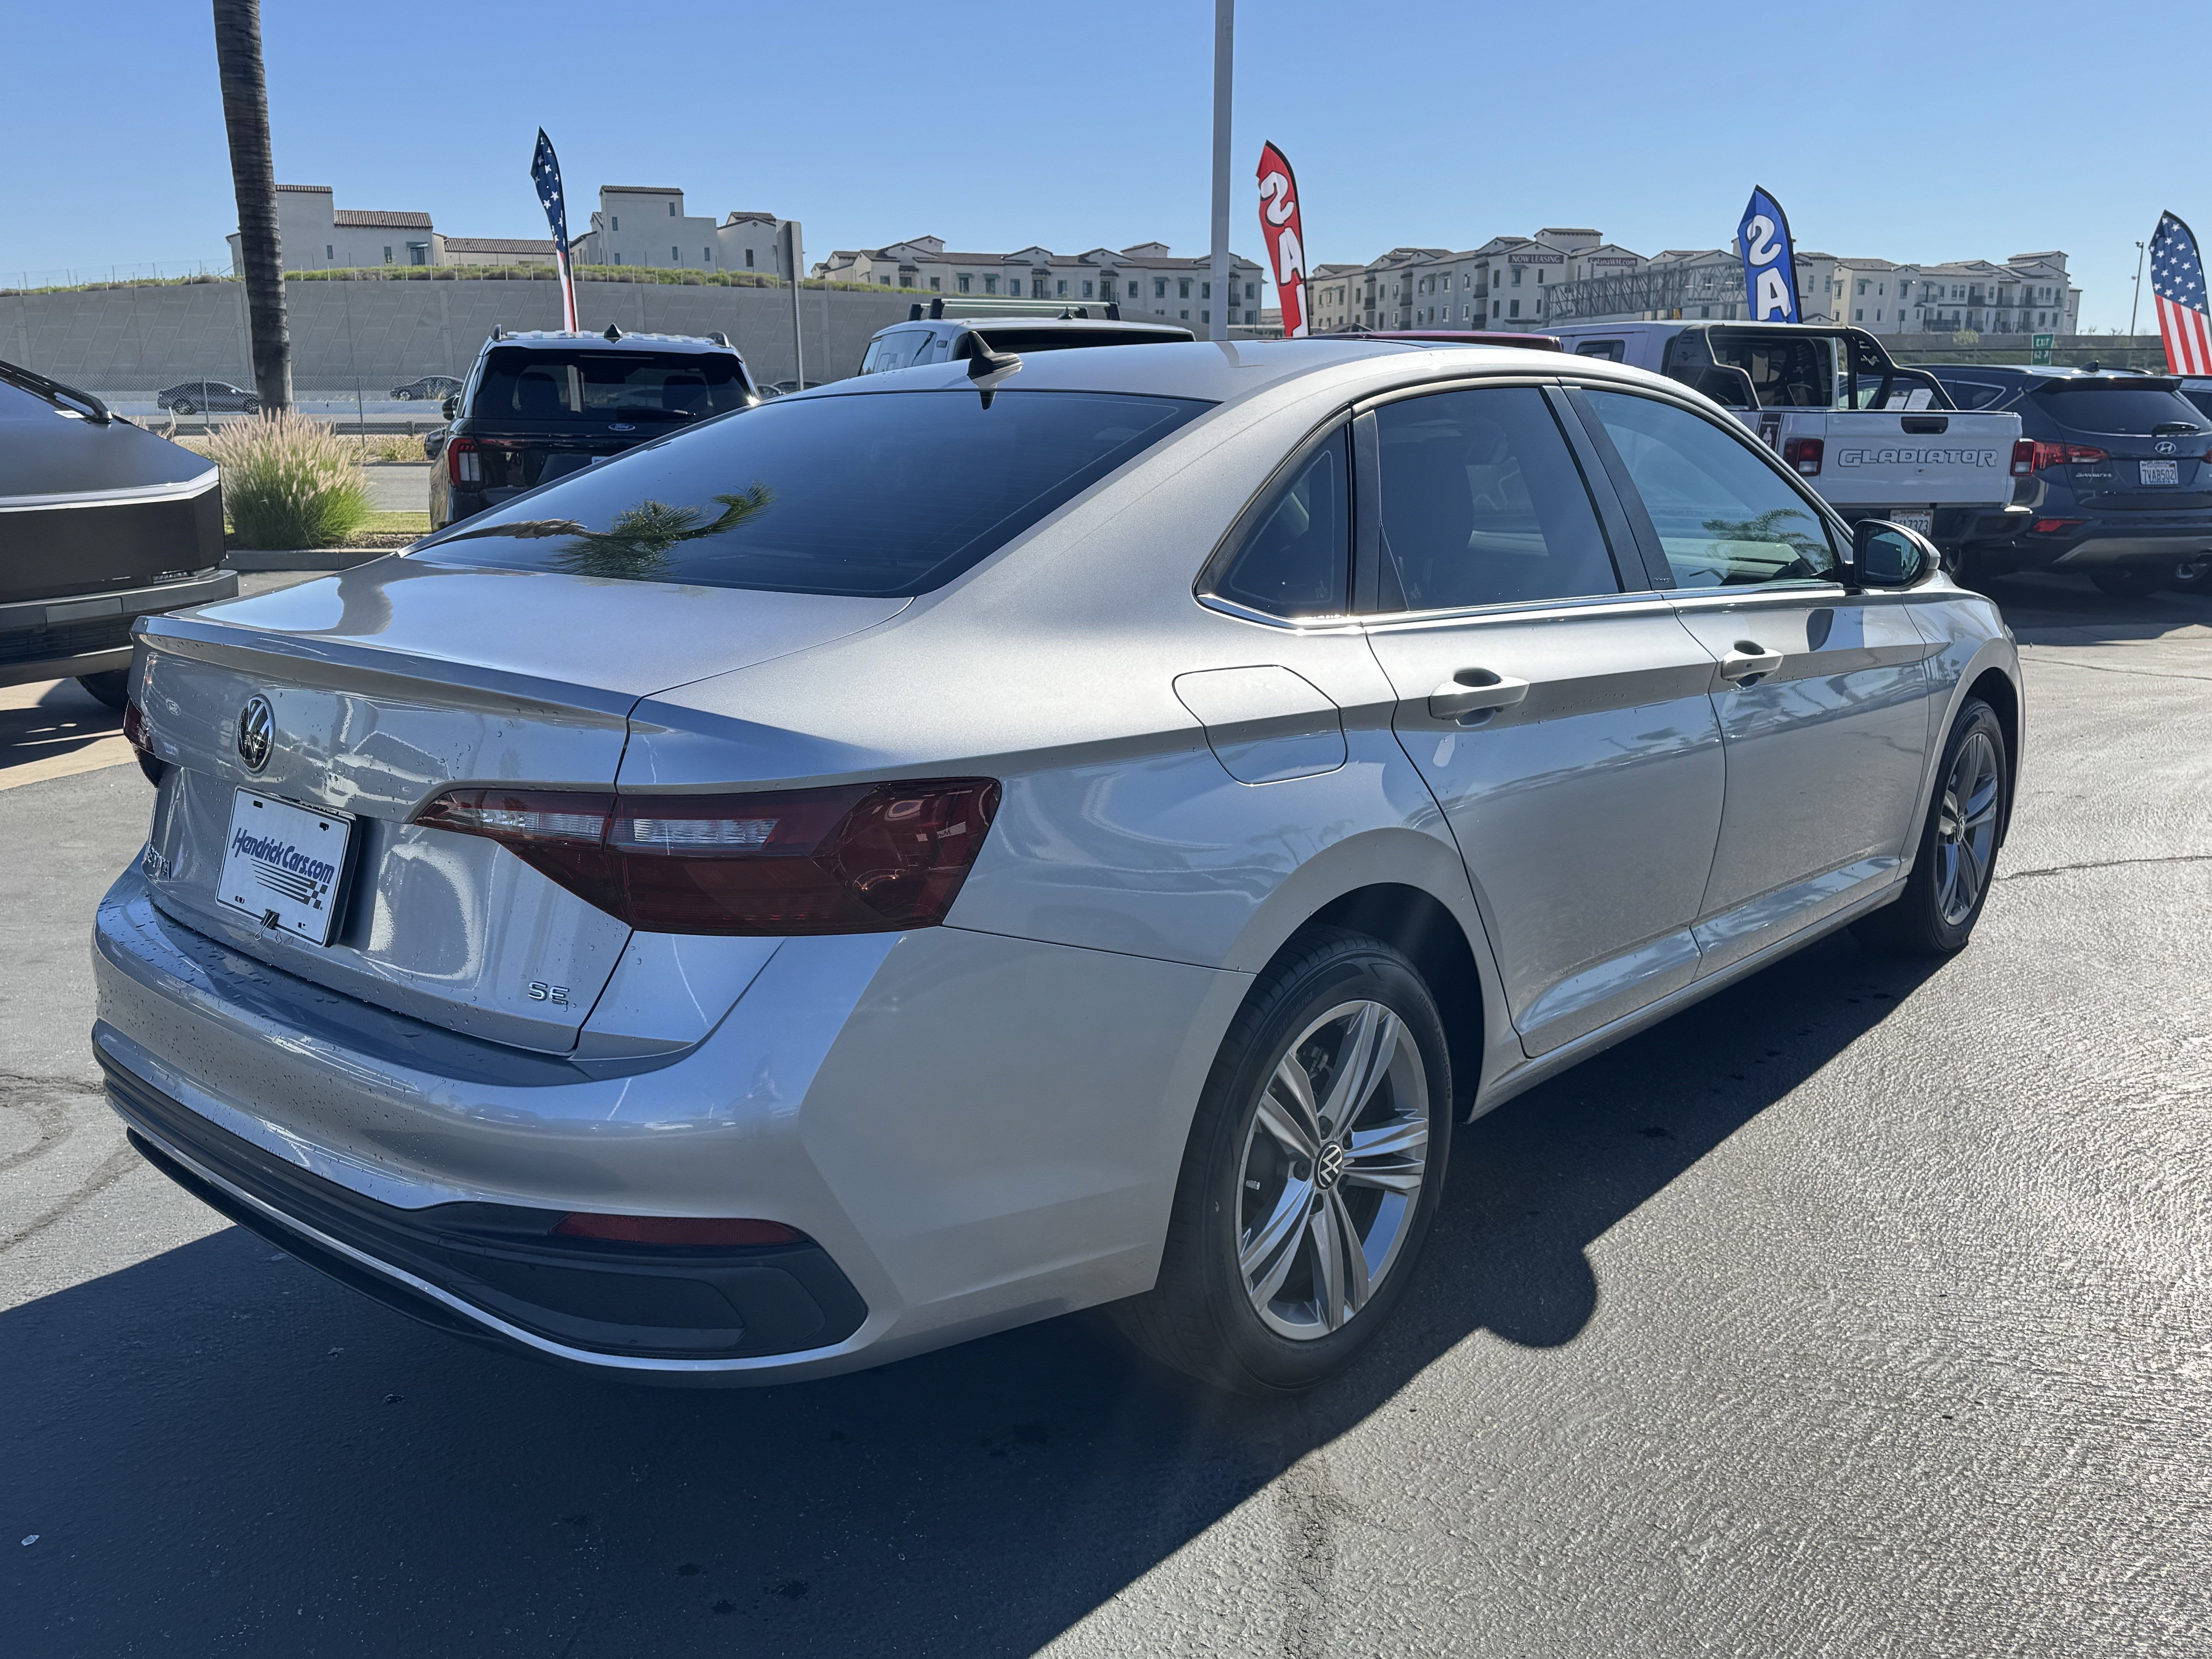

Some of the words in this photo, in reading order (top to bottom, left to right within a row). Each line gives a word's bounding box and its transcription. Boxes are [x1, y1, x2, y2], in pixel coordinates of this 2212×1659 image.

[2036, 338, 2050, 347] EXIT
[1838, 448, 1998, 467] GLADIATOR
[2142, 469, 2175, 481] 7VAB502
[528, 981, 570, 1005] SE
